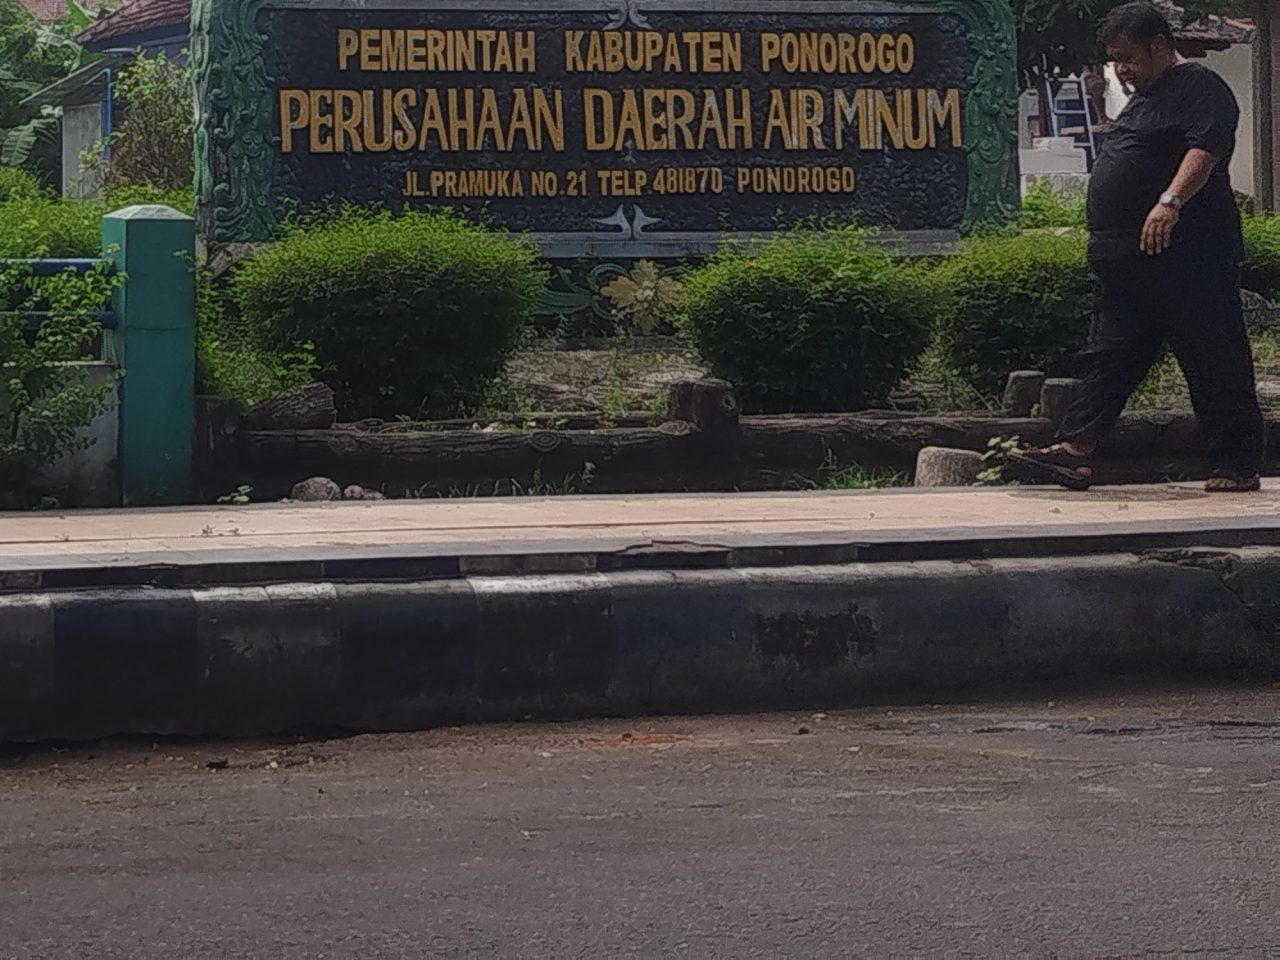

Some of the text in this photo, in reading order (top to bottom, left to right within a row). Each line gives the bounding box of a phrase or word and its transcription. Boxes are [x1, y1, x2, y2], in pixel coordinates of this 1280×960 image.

[337, 28, 916, 75] PEMERINTAH KABUPATEN PONOROGO
[278, 87, 964, 153] PERUSAHAAN DAERAH AIR MINUM
[736, 166, 856, 194] PONOROGO
